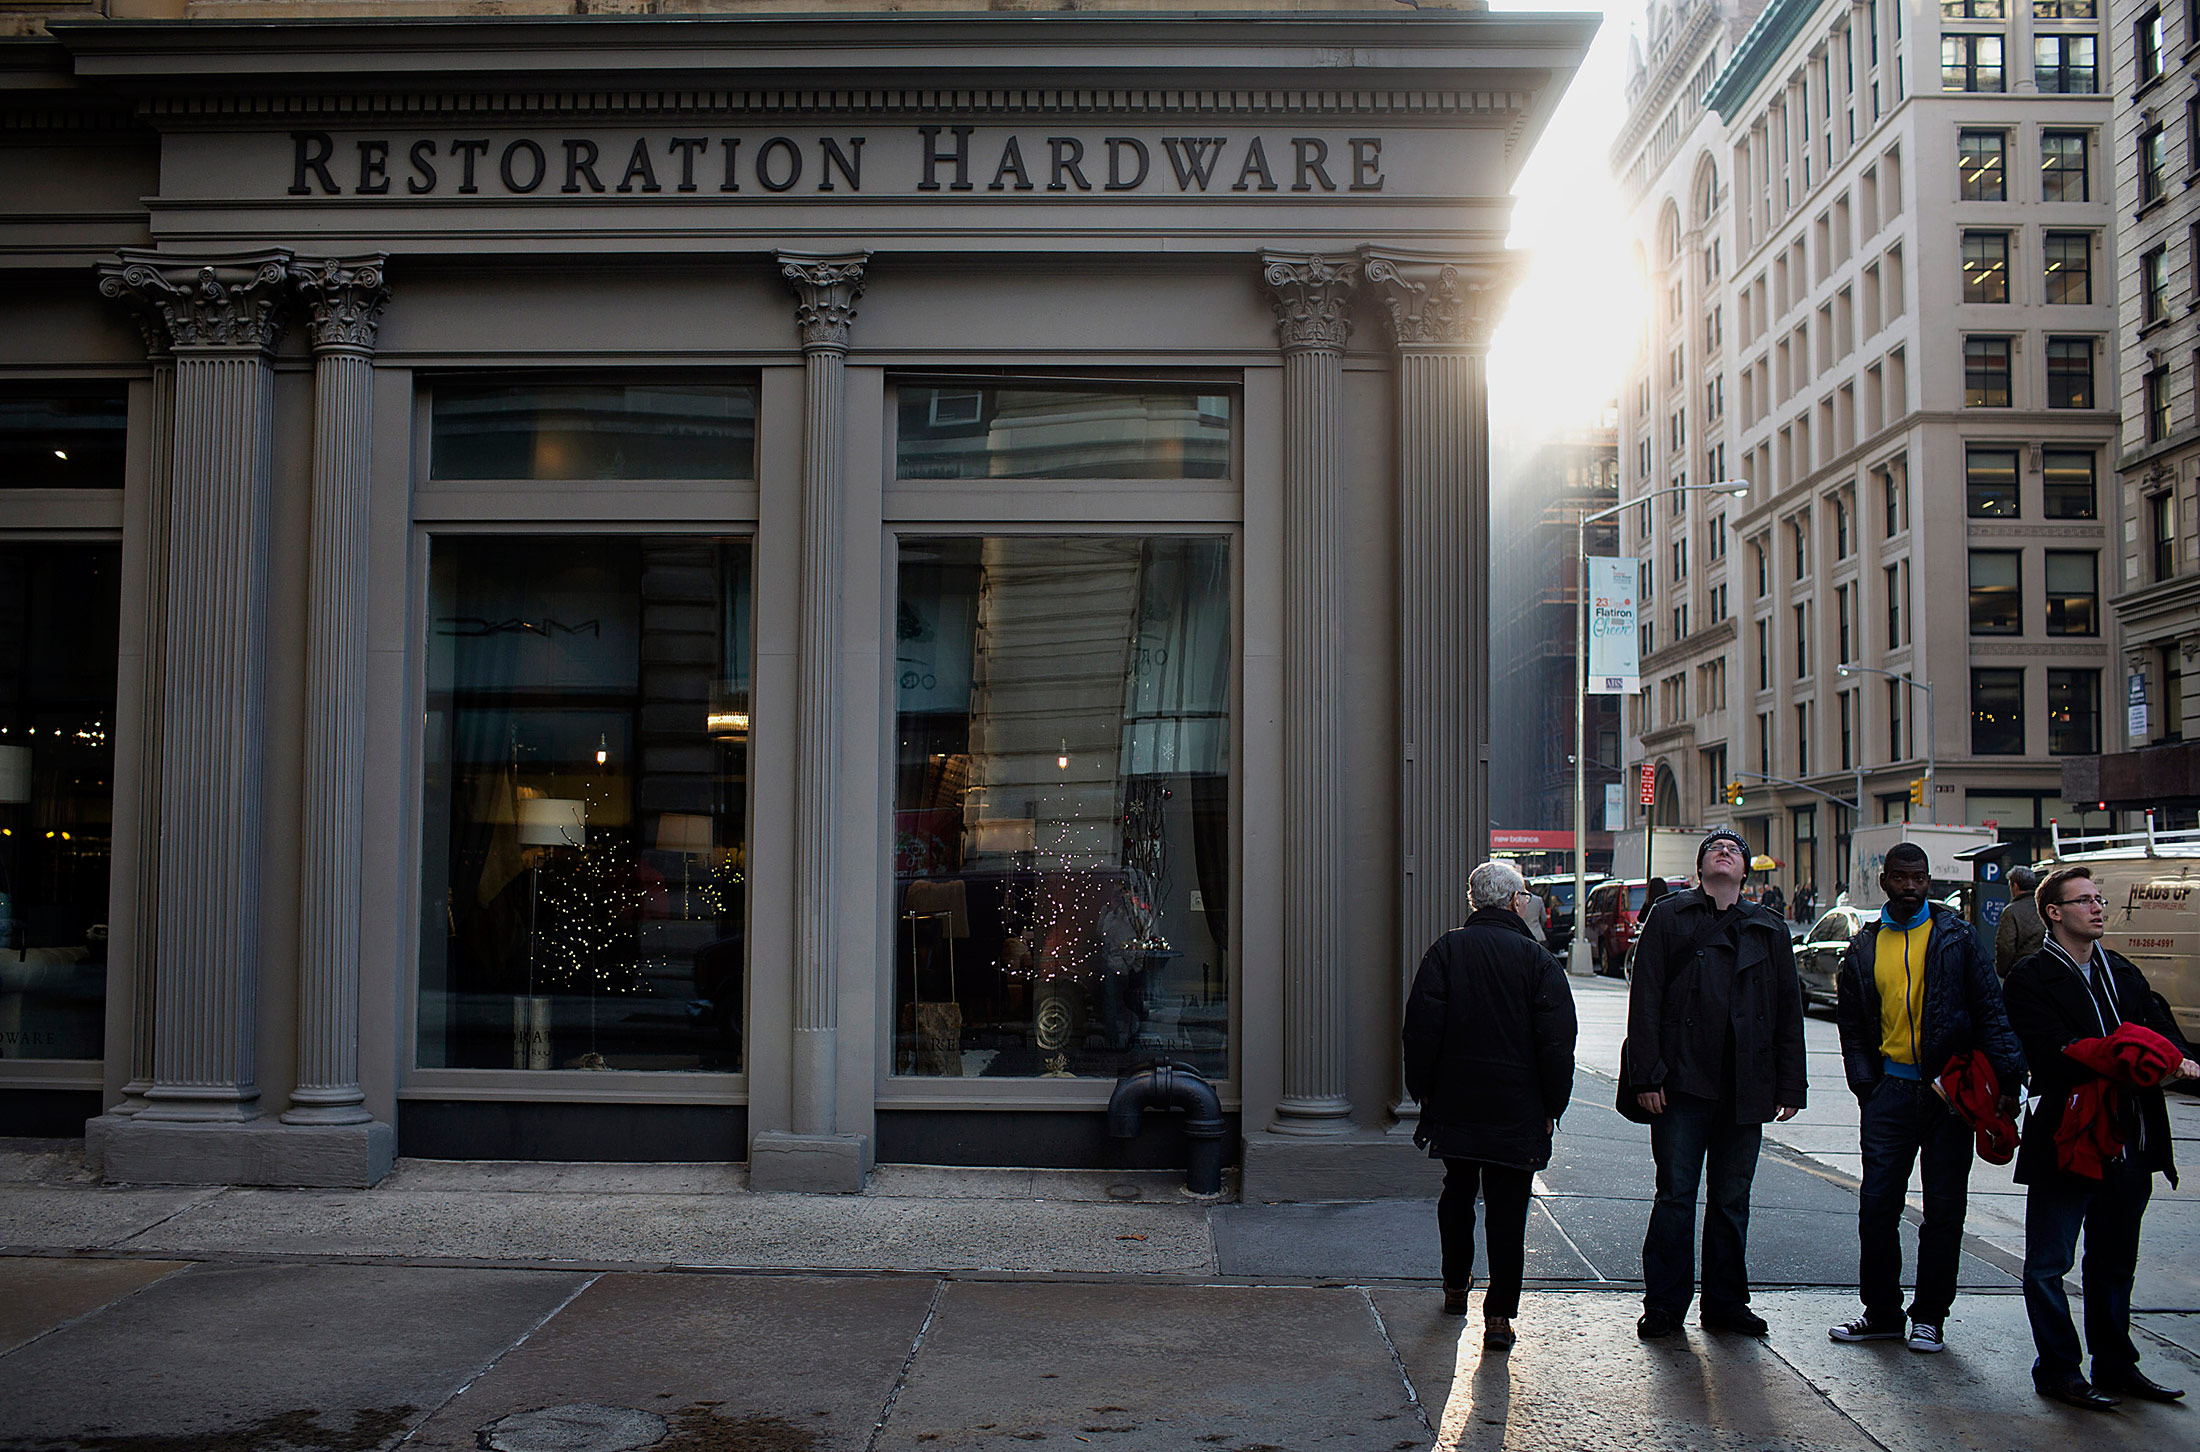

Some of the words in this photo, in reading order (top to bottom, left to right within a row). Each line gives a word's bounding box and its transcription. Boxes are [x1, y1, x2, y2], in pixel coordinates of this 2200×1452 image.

[288, 130, 866, 195] RESTORATION
[917, 126, 1386, 191] HARDWARE
[1595, 597, 1608, 607] 23
[1596, 608, 1632, 617] Flatiron
[1509, 835, 1539, 843] balance
[1987, 863, 1998, 880] P
[2129, 884, 2169, 900] HEADS
[2173, 887, 2191, 901] UP
[2128, 939, 2174, 947] 718-268-4991
[0, 1032, 55, 1045] WARE
